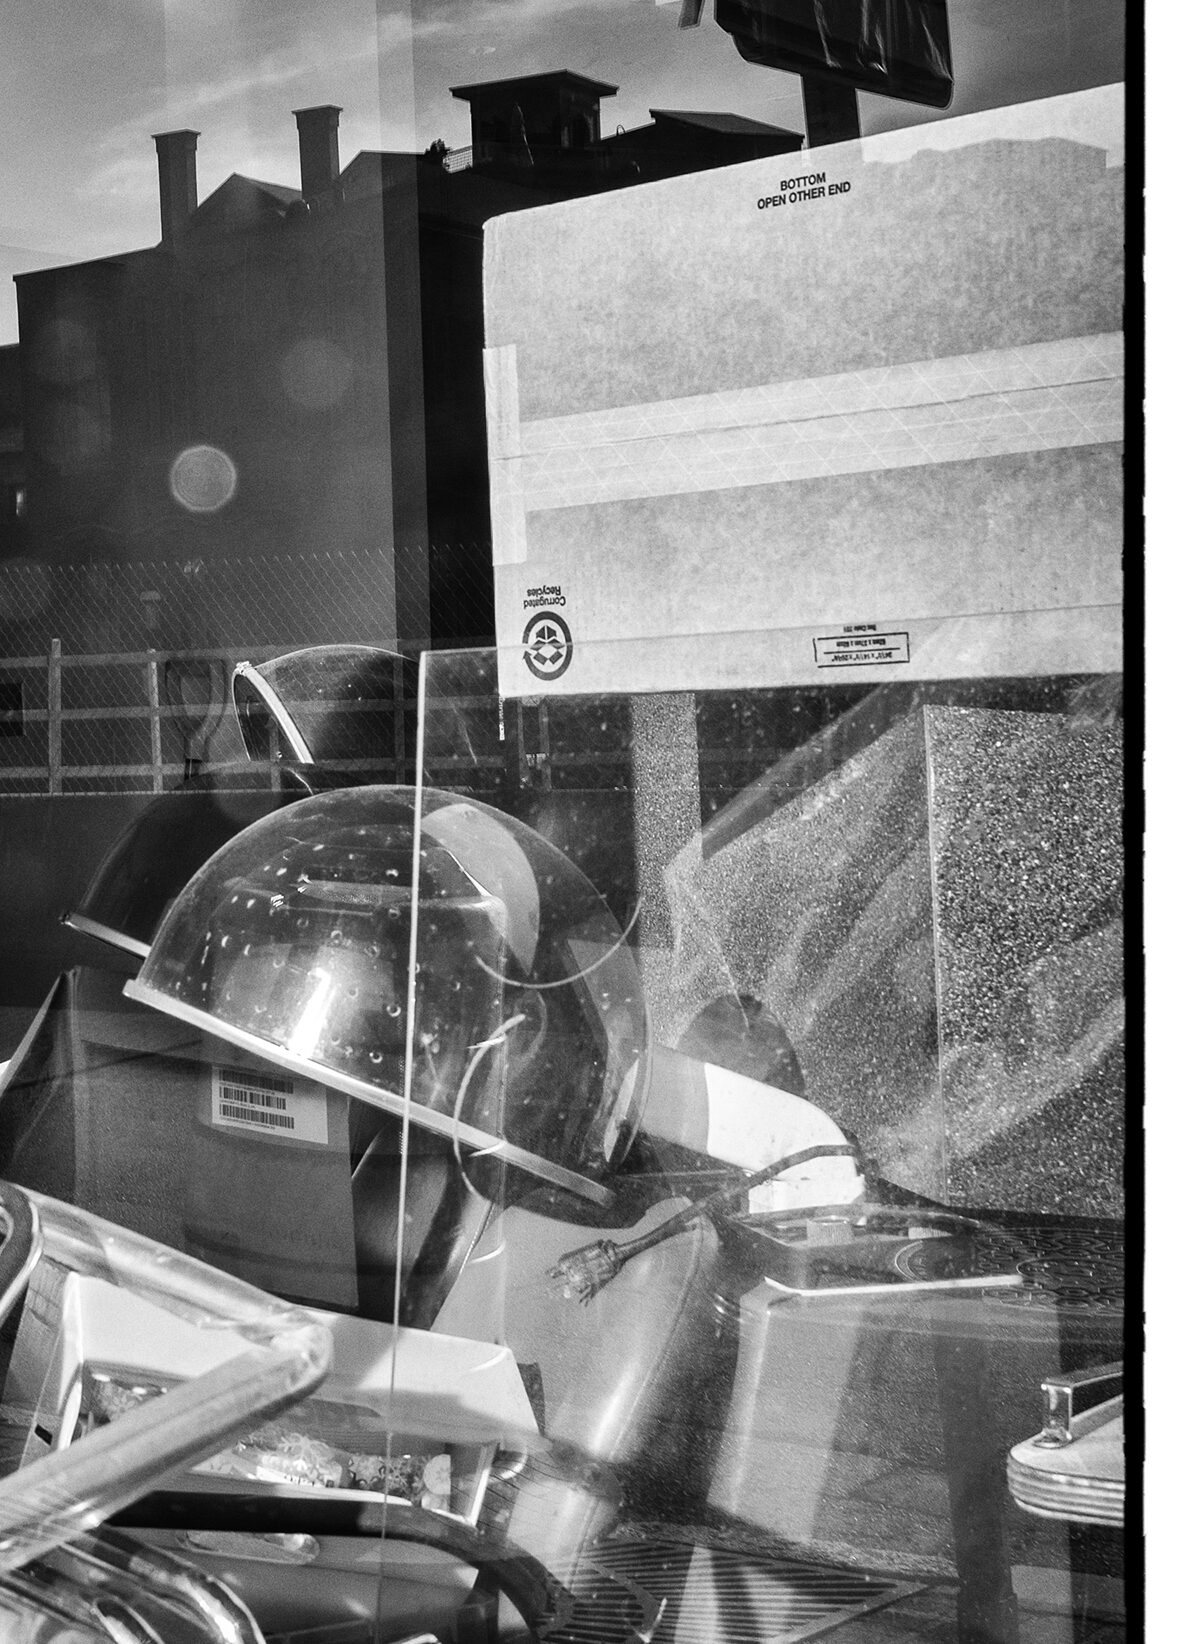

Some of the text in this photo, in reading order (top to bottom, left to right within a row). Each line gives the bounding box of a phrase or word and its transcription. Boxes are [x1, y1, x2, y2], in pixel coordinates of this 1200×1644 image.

[780, 172, 826, 191] BOTTOM
[757, 181, 851, 209] OPEN OTHER END
[527, 585, 561, 597] Recycles
[523, 596, 566, 609] Corrugated
